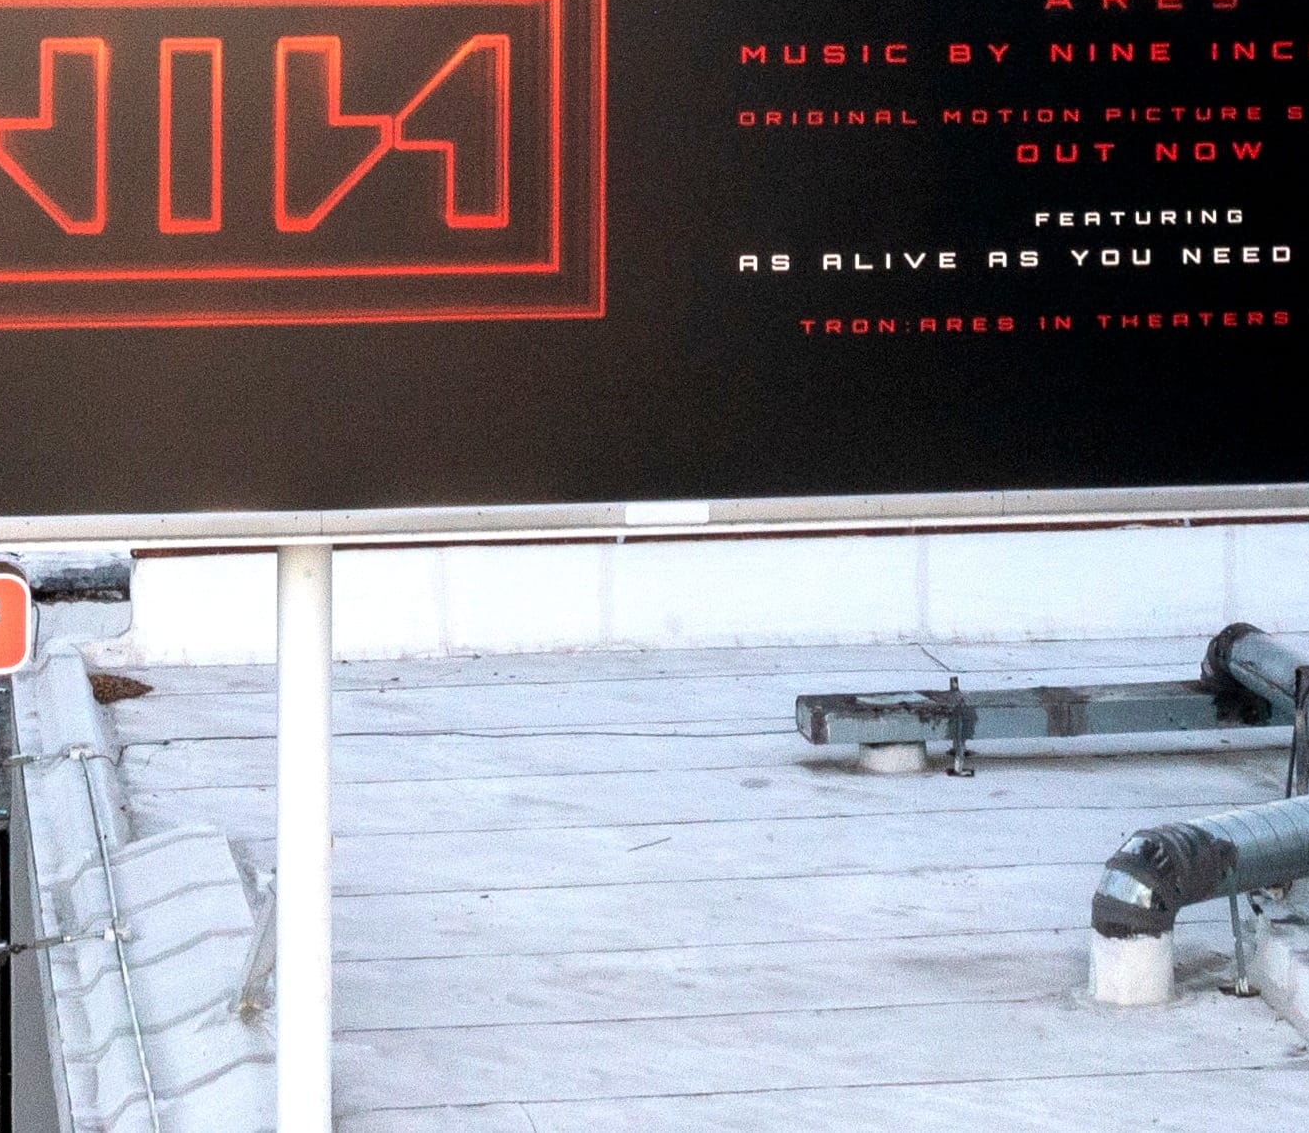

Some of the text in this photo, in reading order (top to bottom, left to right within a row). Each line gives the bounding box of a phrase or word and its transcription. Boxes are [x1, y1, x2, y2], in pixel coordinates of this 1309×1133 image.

[740, 43, 907, 65] MUSIC
[949, 43, 1009, 64] BY
[1051, 42, 1171, 63] NINE
[738, 109, 917, 127] ORIGINAL
[943, 108, 1080, 124] MOTION
[1106, 106, 1262, 122] PICTURE
[1017, 141, 1264, 164] OUT NOW
[1035, 209, 1244, 227] FEATURING
[739, 254, 791, 272] AS
[823, 252, 957, 271] ALIVE
[988, 251, 1039, 268] AS
[1071, 249, 1151, 266] YOU
[1182, 246, 1291, 264] NEED
[1039, 315, 1072, 330] IN
[1098, 310, 1289, 329] THEATERS
